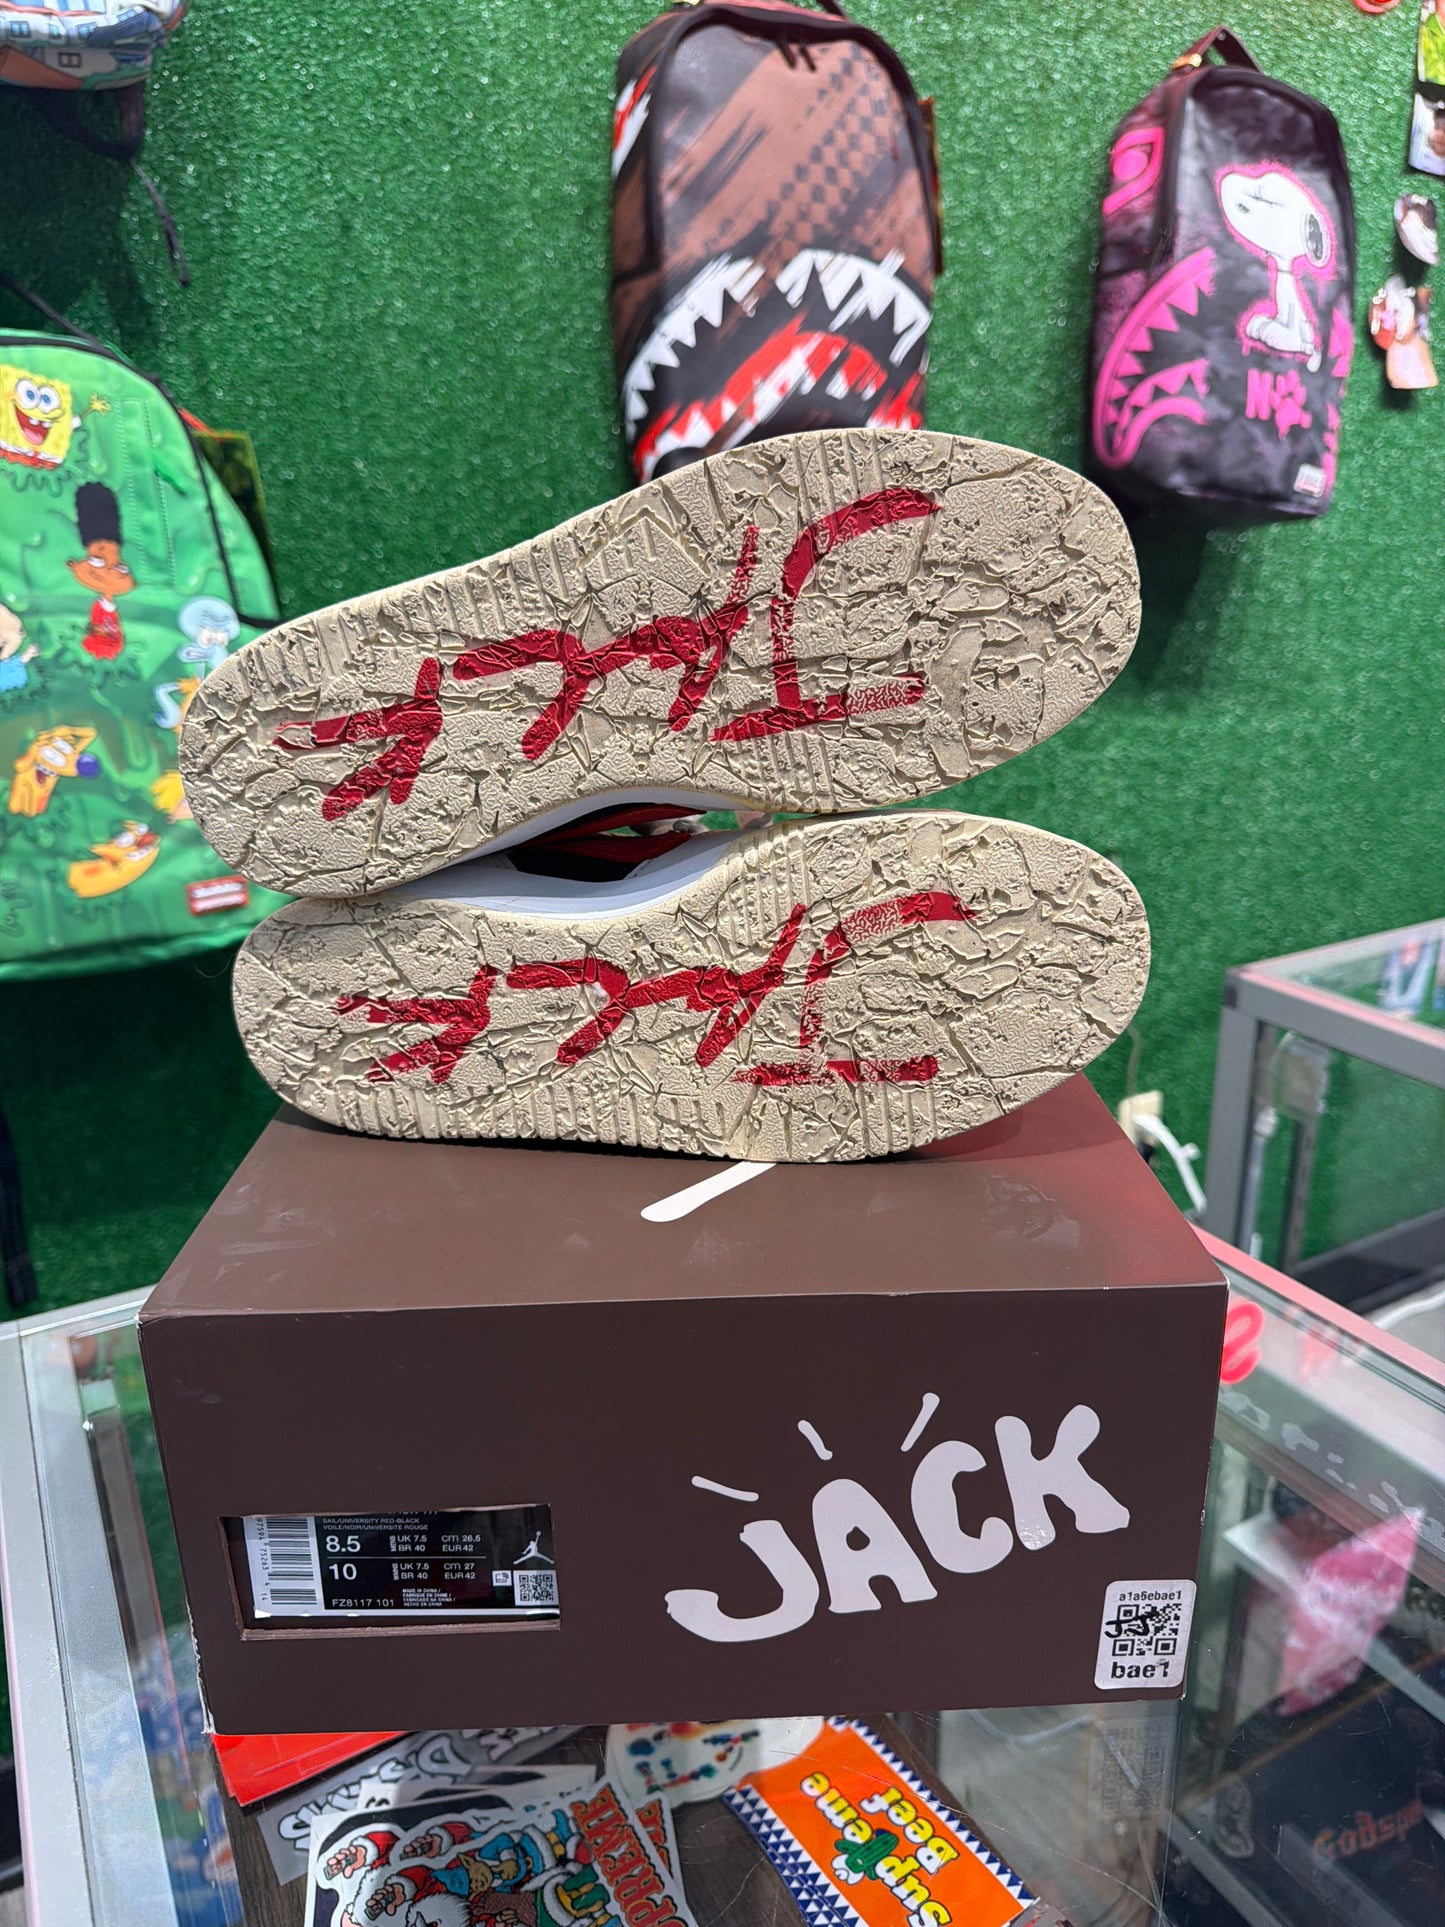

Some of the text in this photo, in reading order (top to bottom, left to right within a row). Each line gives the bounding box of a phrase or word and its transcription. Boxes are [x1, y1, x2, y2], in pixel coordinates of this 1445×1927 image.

[664, 1404, 1131, 1643] JACK
[397, 1534, 428, 1542] UK 7.5
[462, 1534, 481, 1542] 26.5
[325, 1535, 361, 1553] 8.5
[398, 1544, 426, 1552] BR 40
[442, 1544, 474, 1552] EUR 42
[400, 1562, 430, 1570] UK 7.5
[464, 1562, 475, 1570] 27
[328, 1563, 357, 1580] 10
[400, 1571, 428, 1580] BR 40
[444, 1571, 476, 1580] EUR 42
[332, 1598, 395, 1607] FZ8117 101
[859, 1786, 960, 1875] Beef
[800, 1771, 953, 1927] Supeme
[568, 1783, 690, 1927] PREME
